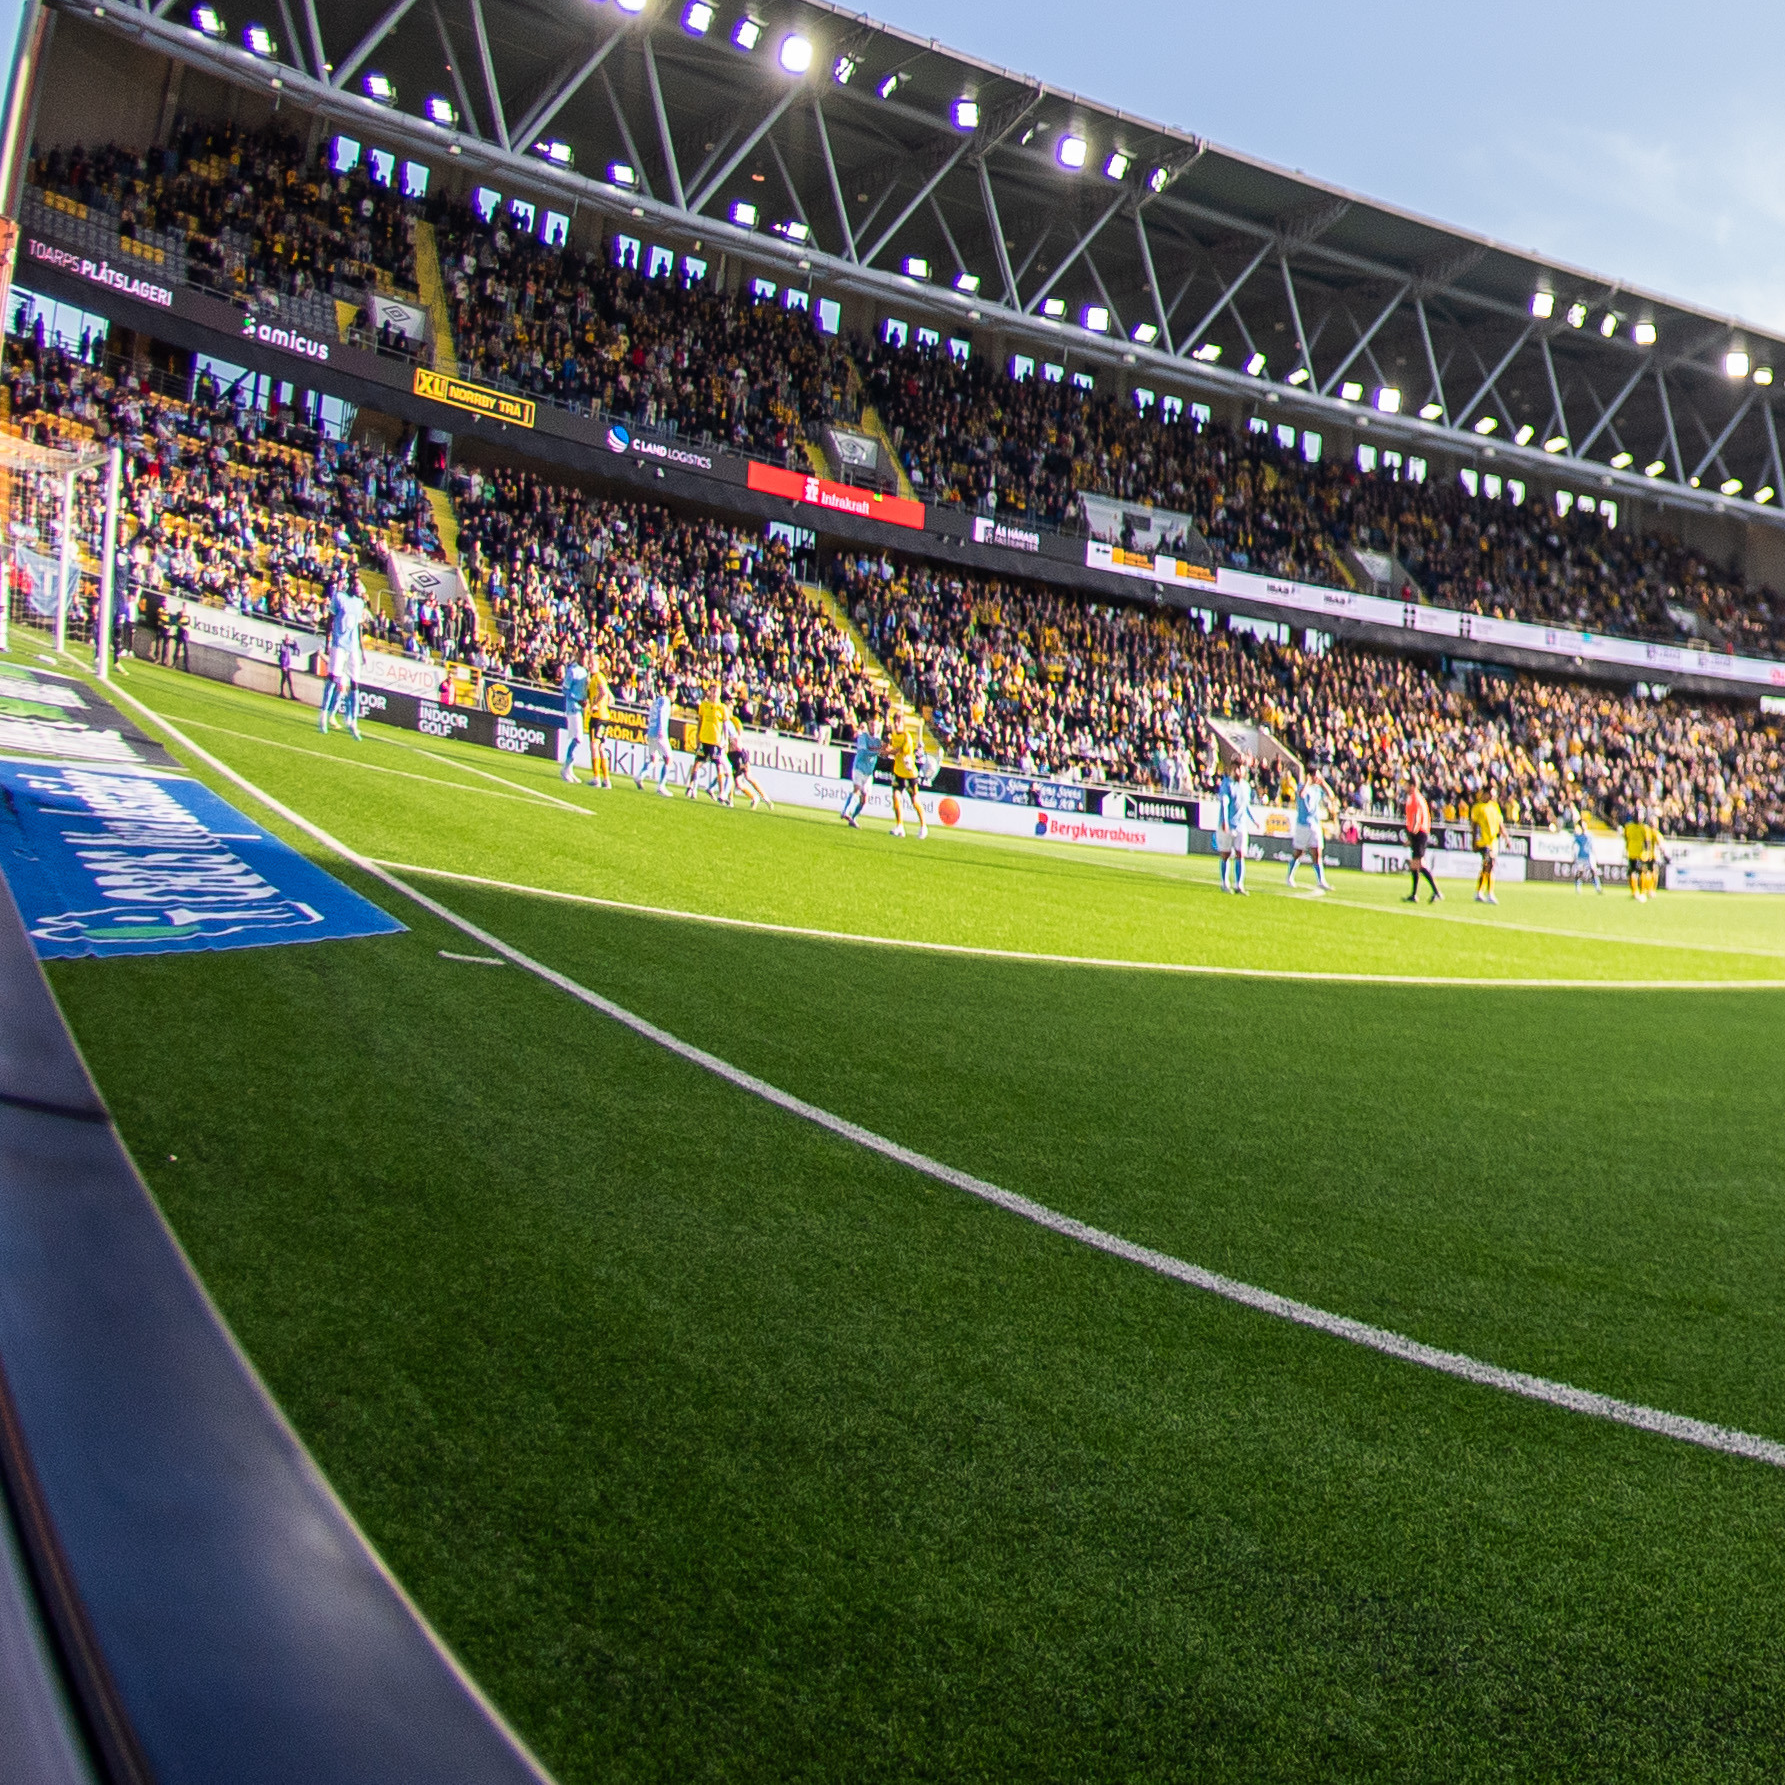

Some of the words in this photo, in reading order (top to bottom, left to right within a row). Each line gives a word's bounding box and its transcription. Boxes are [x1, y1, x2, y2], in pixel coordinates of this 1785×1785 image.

[28, 238, 80, 273] TOARPS
[80, 259, 173, 307] PLÅTSLAGERI
[258, 323, 329, 360] amicus
[418, 373, 446, 398] XL
[449, 386, 498, 411] NORRBY
[821, 491, 870, 516] Infrakraft
[187, 614, 300, 657] kustikgruppn
[385, 664, 434, 688] ARVID
[418, 718, 452, 737] GOLF
[419, 705, 468, 730] INDOOR
[496, 736, 529, 754] GOLF
[497, 723, 546, 746] INDOOR
[1050, 820, 1146, 846] Bergkvarabuss
